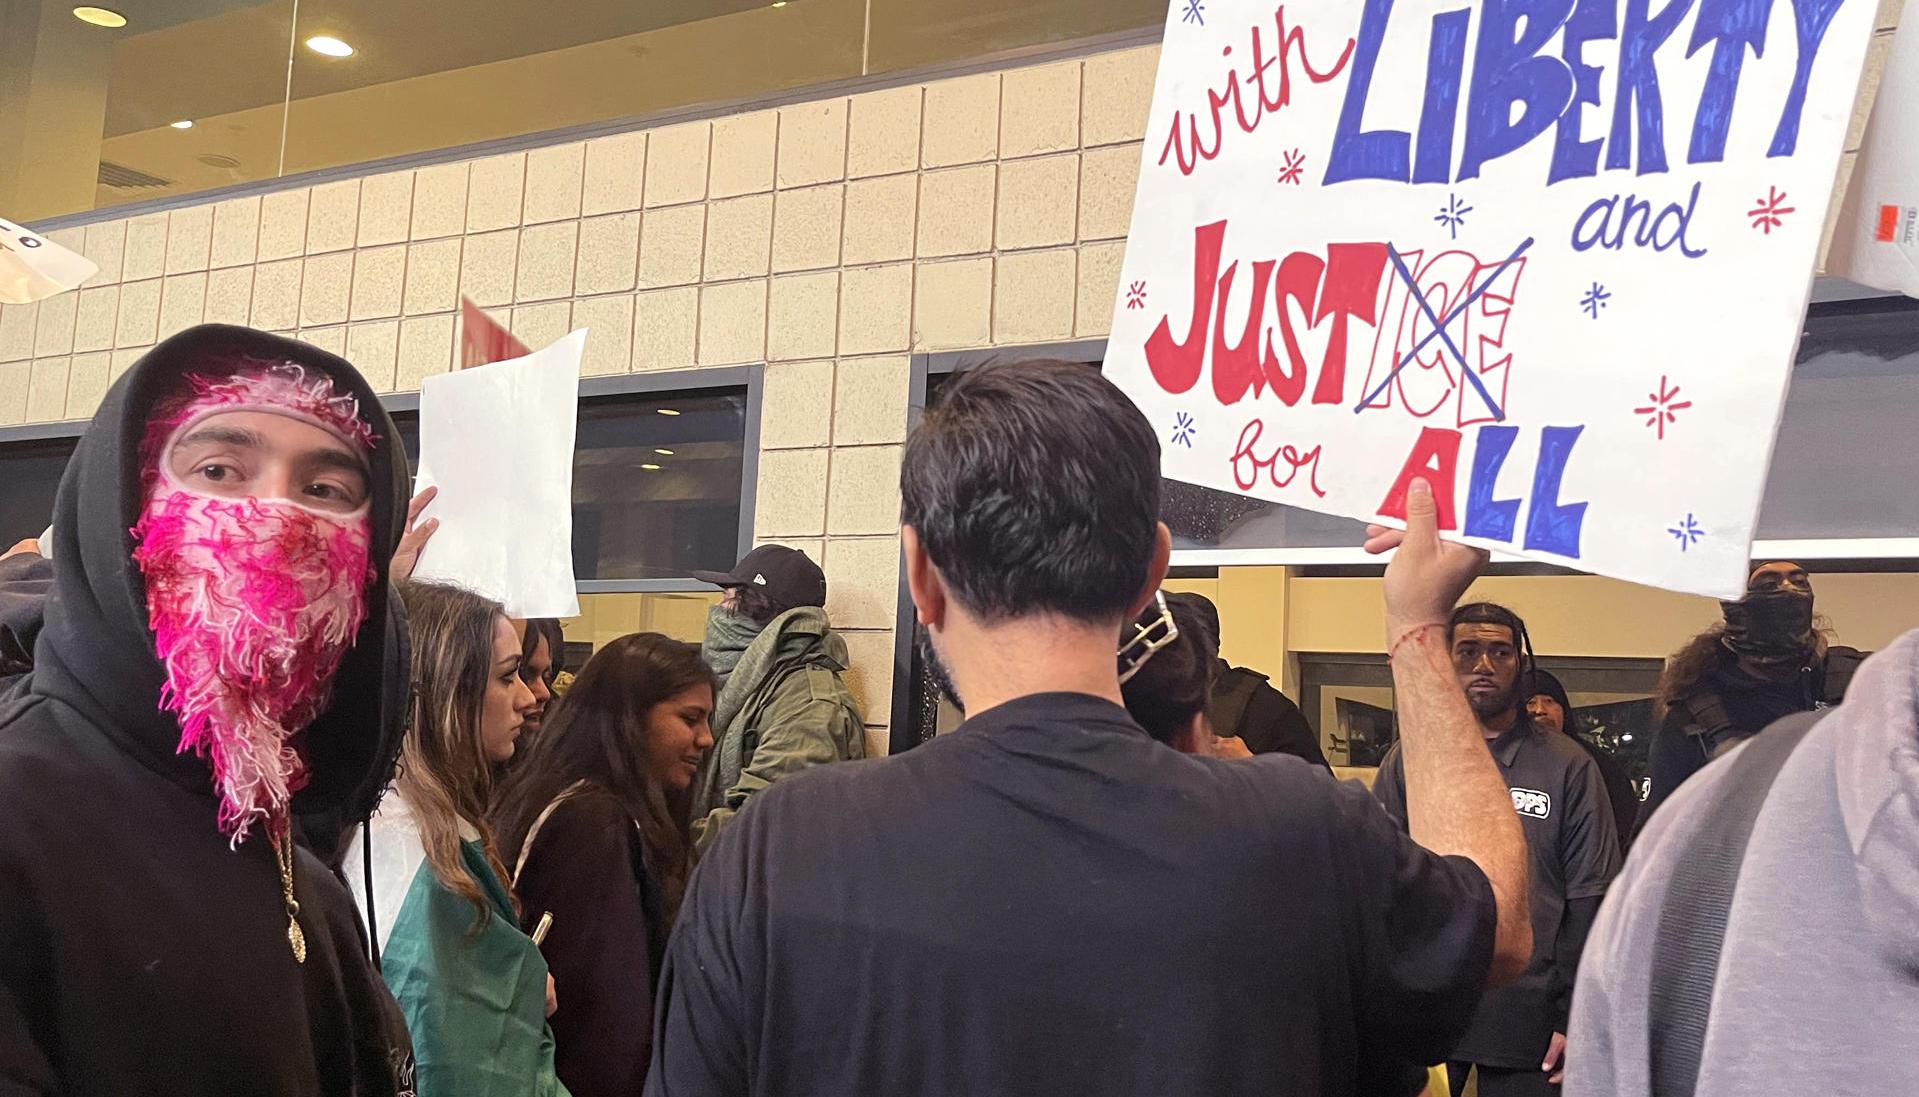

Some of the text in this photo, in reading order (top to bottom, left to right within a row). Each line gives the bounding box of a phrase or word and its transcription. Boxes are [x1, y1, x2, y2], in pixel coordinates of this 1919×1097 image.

[1158, 0, 1845, 186] with LIBERTY
[1571, 181, 1708, 258] and
[1376, 425, 1588, 558] ALL
